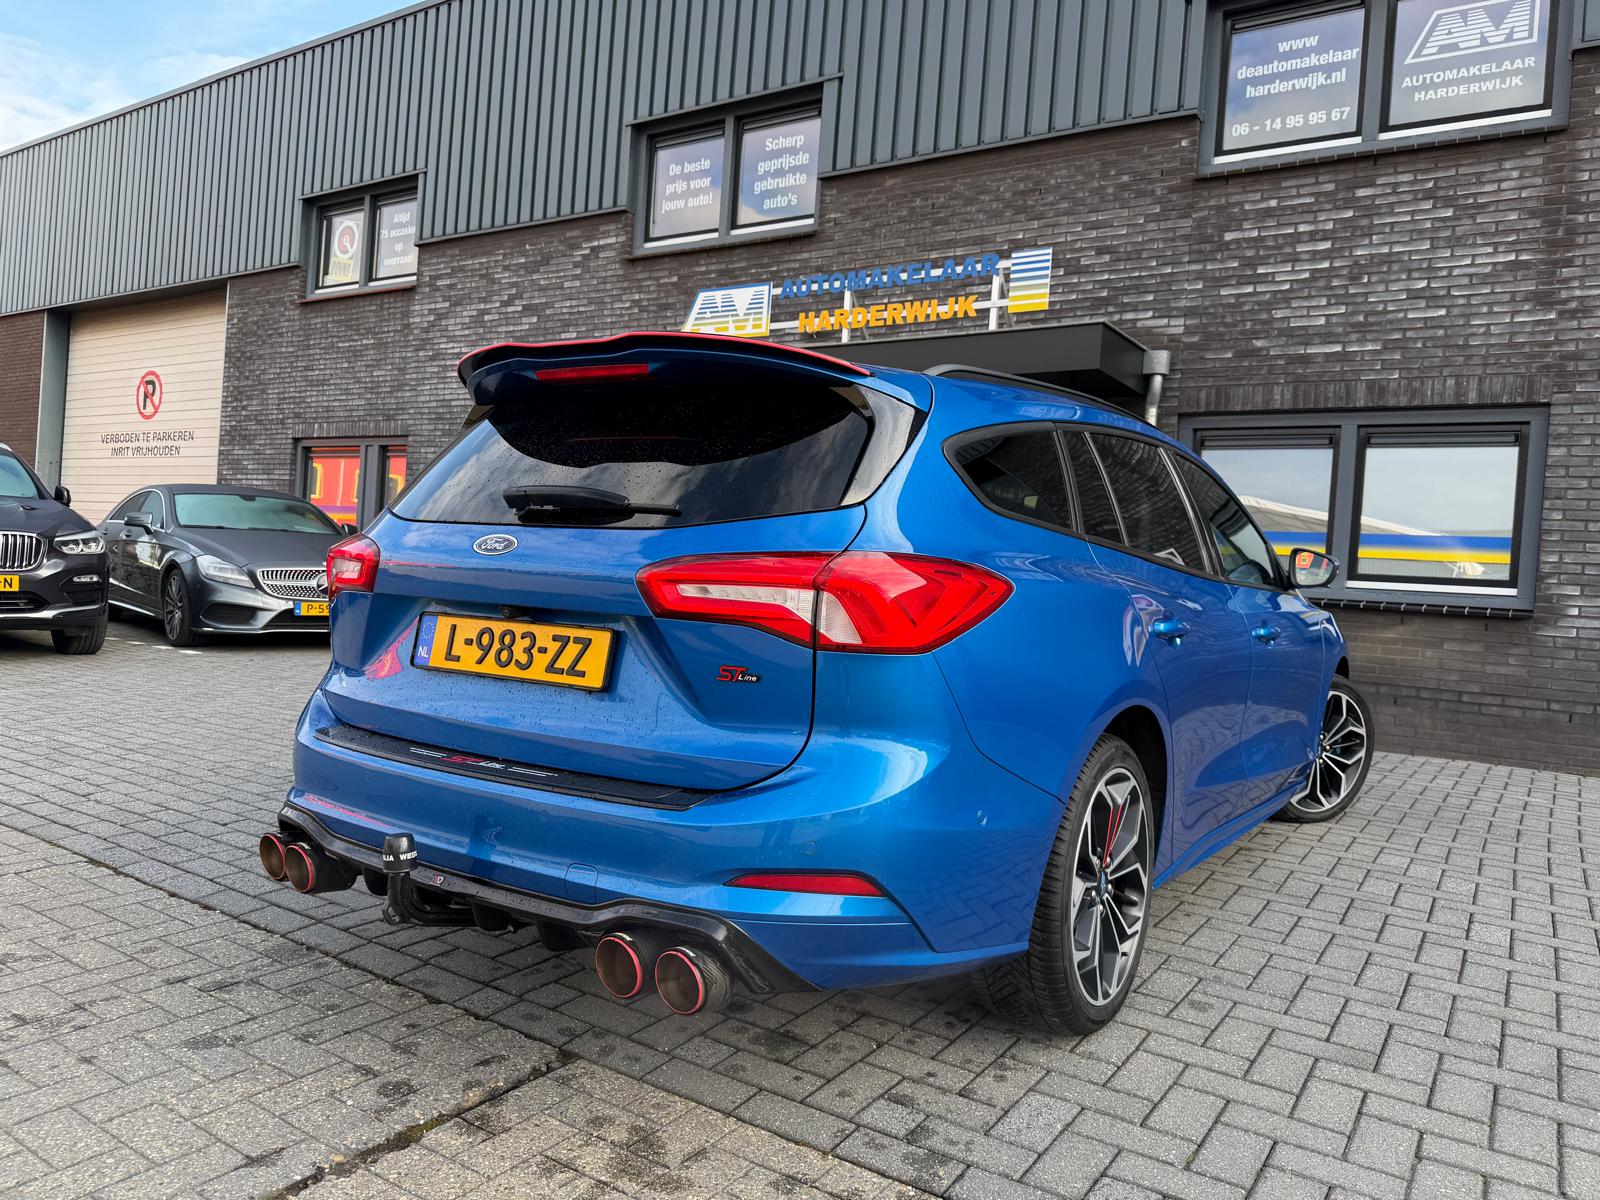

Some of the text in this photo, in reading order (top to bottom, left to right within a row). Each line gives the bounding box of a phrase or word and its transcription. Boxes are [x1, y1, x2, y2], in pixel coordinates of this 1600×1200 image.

[1277, 35, 1319, 53] www
[1236, 47, 1360, 80] deautomakelaar
[1401, 56, 1536, 88] AUTOMAKELAAR
[1245, 67, 1347, 98] harderwijk.nl
[1413, 75, 1523, 102] HARDERWIJK
[1231, 122, 1249, 137] 06
[1264, 117, 1282, 132] 14
[1285, 113, 1304, 129] 95
[1308, 110, 1327, 125] 95
[1331, 106, 1350, 121] 67
[765, 134, 804, 151] Scherp
[669, 158, 711, 176] De beste
[757, 152, 810, 175] geprijsde
[665, 176, 712, 196] prijs voor
[754, 172, 807, 195] gebruikte
[661, 193, 713, 214] jouw auto!
[763, 194, 798, 210] auto's
[780, 252, 1000, 299] AUTOMAKELAAR
[798, 294, 978, 334] HARDERWIJK
[101, 430, 194, 444] VERBODEN TE PARKEREN
[111, 445, 181, 457] INRIT VRIJHOUDEN
[481, 537, 508, 549] Ford
[417, 645, 429, 658] NL
[444, 623, 593, 678] L-983-ZZ
[716, 665, 748, 682] ST
